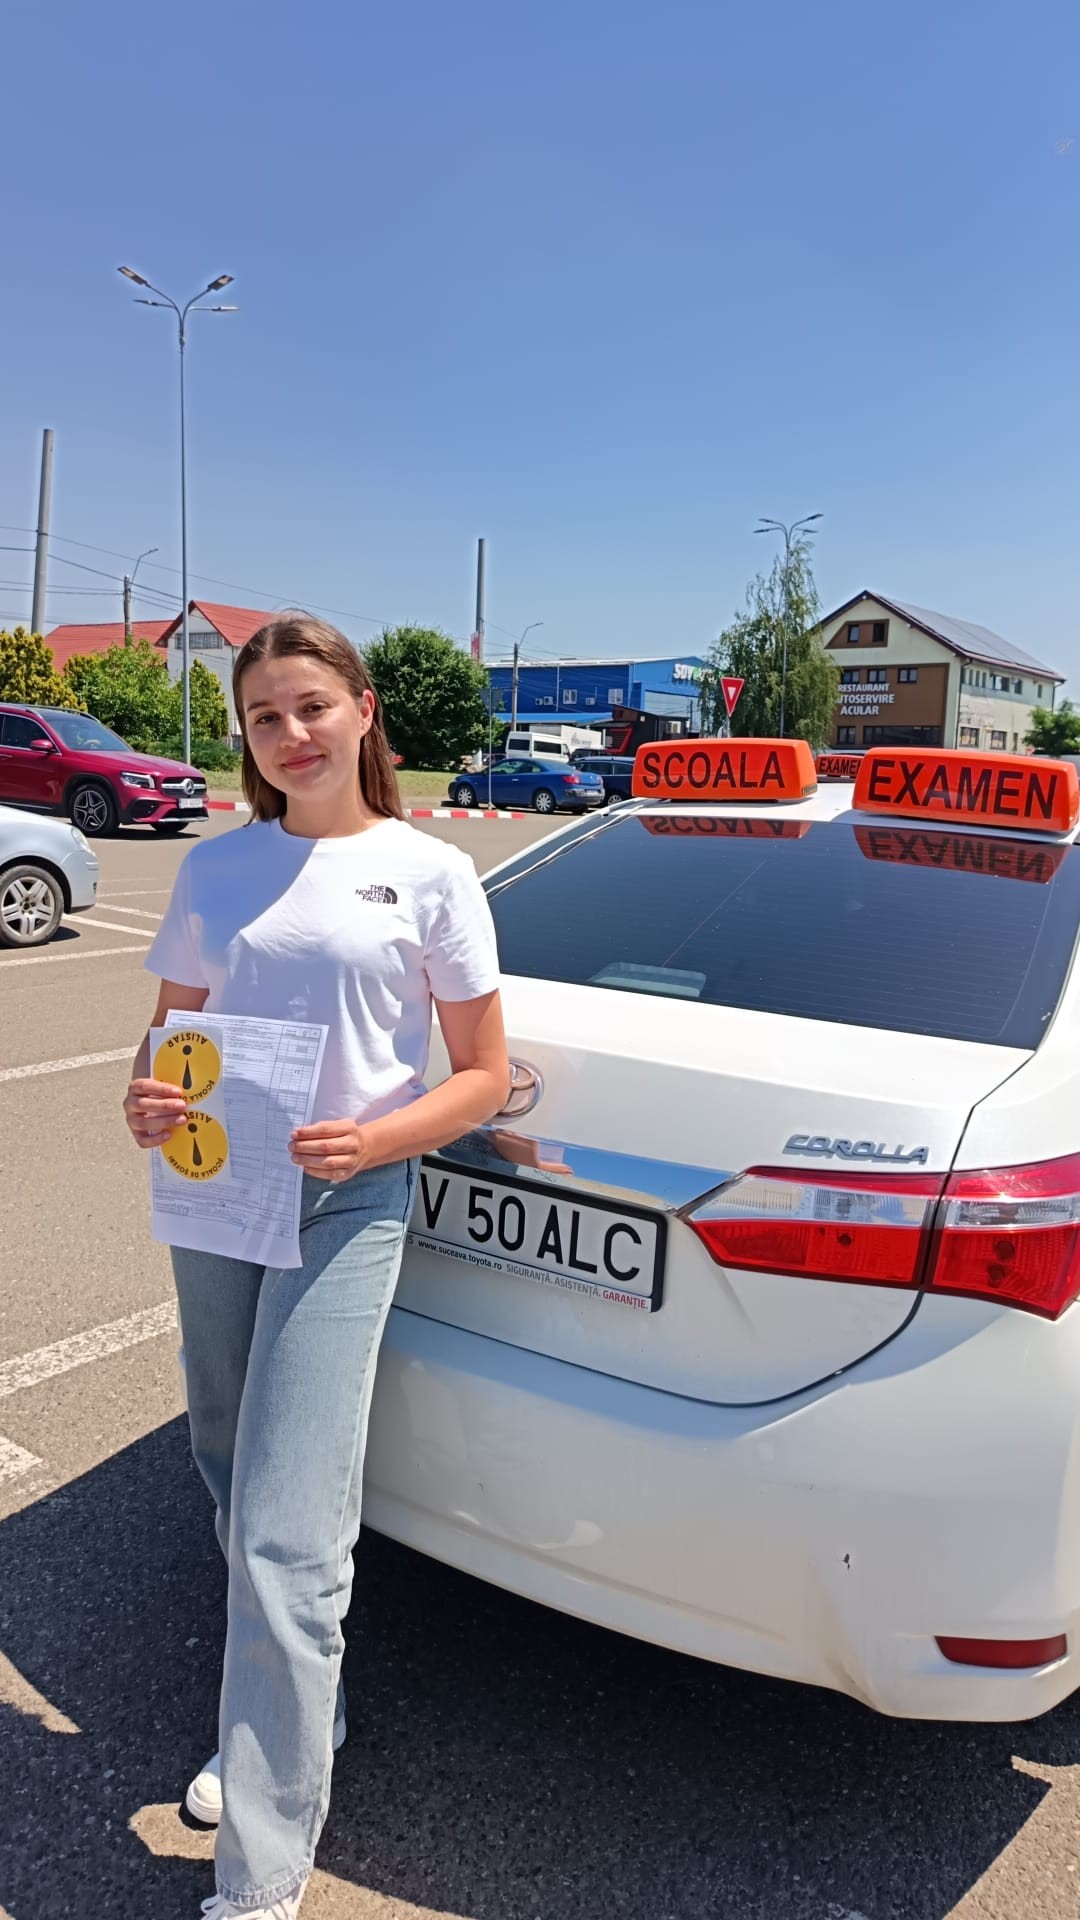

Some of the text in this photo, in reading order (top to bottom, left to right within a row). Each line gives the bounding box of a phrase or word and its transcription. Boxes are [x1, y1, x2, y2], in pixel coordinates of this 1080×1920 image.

[837, 683, 889, 692] RESTAURANT
[835, 694, 895, 704] UTOSERVIRE
[840, 705, 879, 715] ACULAR
[642, 751, 785, 789] SCOALA
[867, 758, 1057, 820] EXAMEN
[355, 888, 384, 897] NORTH
[369, 884, 385, 892] THE
[362, 894, 384, 903] FACE
[167, 1032, 208, 1048] ALISTAR
[782, 1133, 930, 1166] COROLLA
[420, 1173, 642, 1281] V 50 ALC
[418, 1239, 503, 1271] www.suceava.toyota.ro
